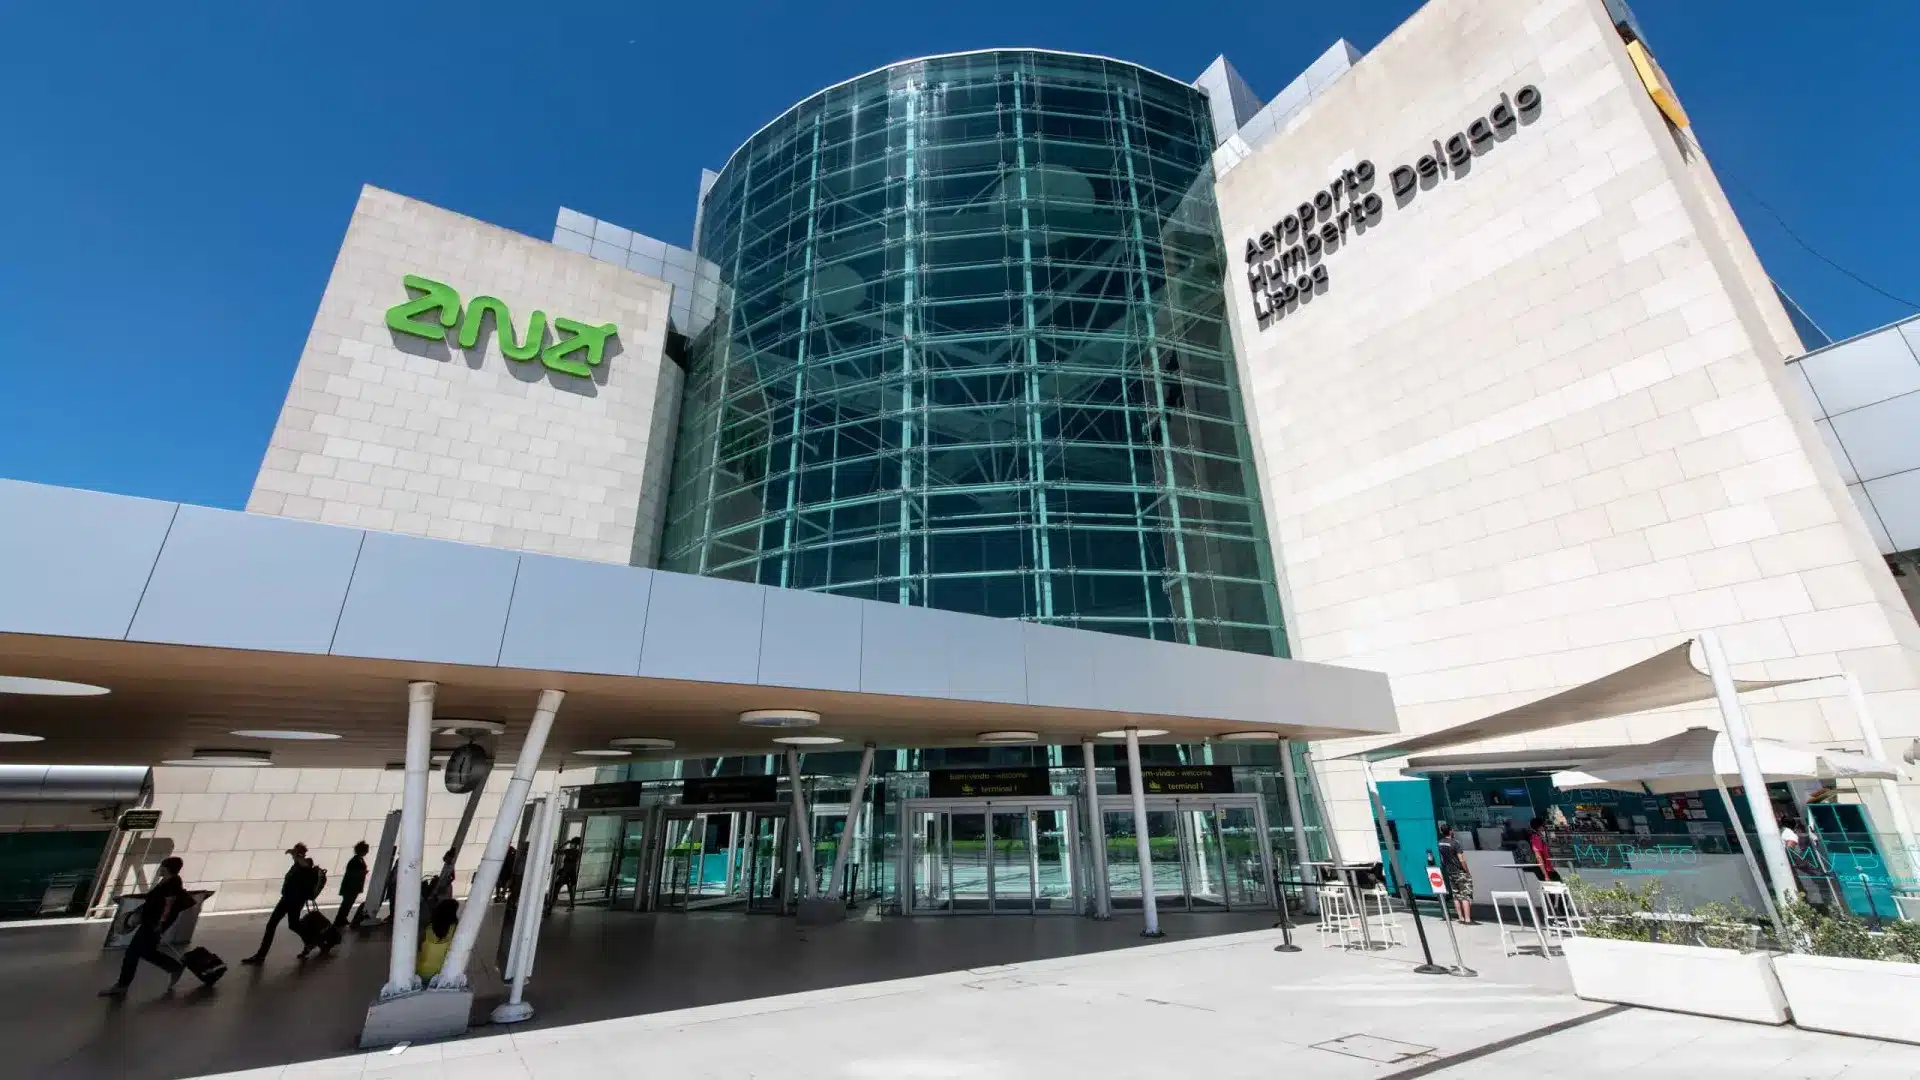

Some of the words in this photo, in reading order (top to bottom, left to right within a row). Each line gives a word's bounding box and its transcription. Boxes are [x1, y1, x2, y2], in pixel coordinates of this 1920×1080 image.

[1245, 160, 1375, 263] Aeroporto
[1247, 192, 1383, 294] Humberto
[1389, 85, 1541, 204] Delgado
[1252, 264, 1328, 324] Lisboa
[1168, 782, 1199, 790] terminal
[1573, 844, 1609, 866] My
[1616, 844, 1697, 864] Bistro
